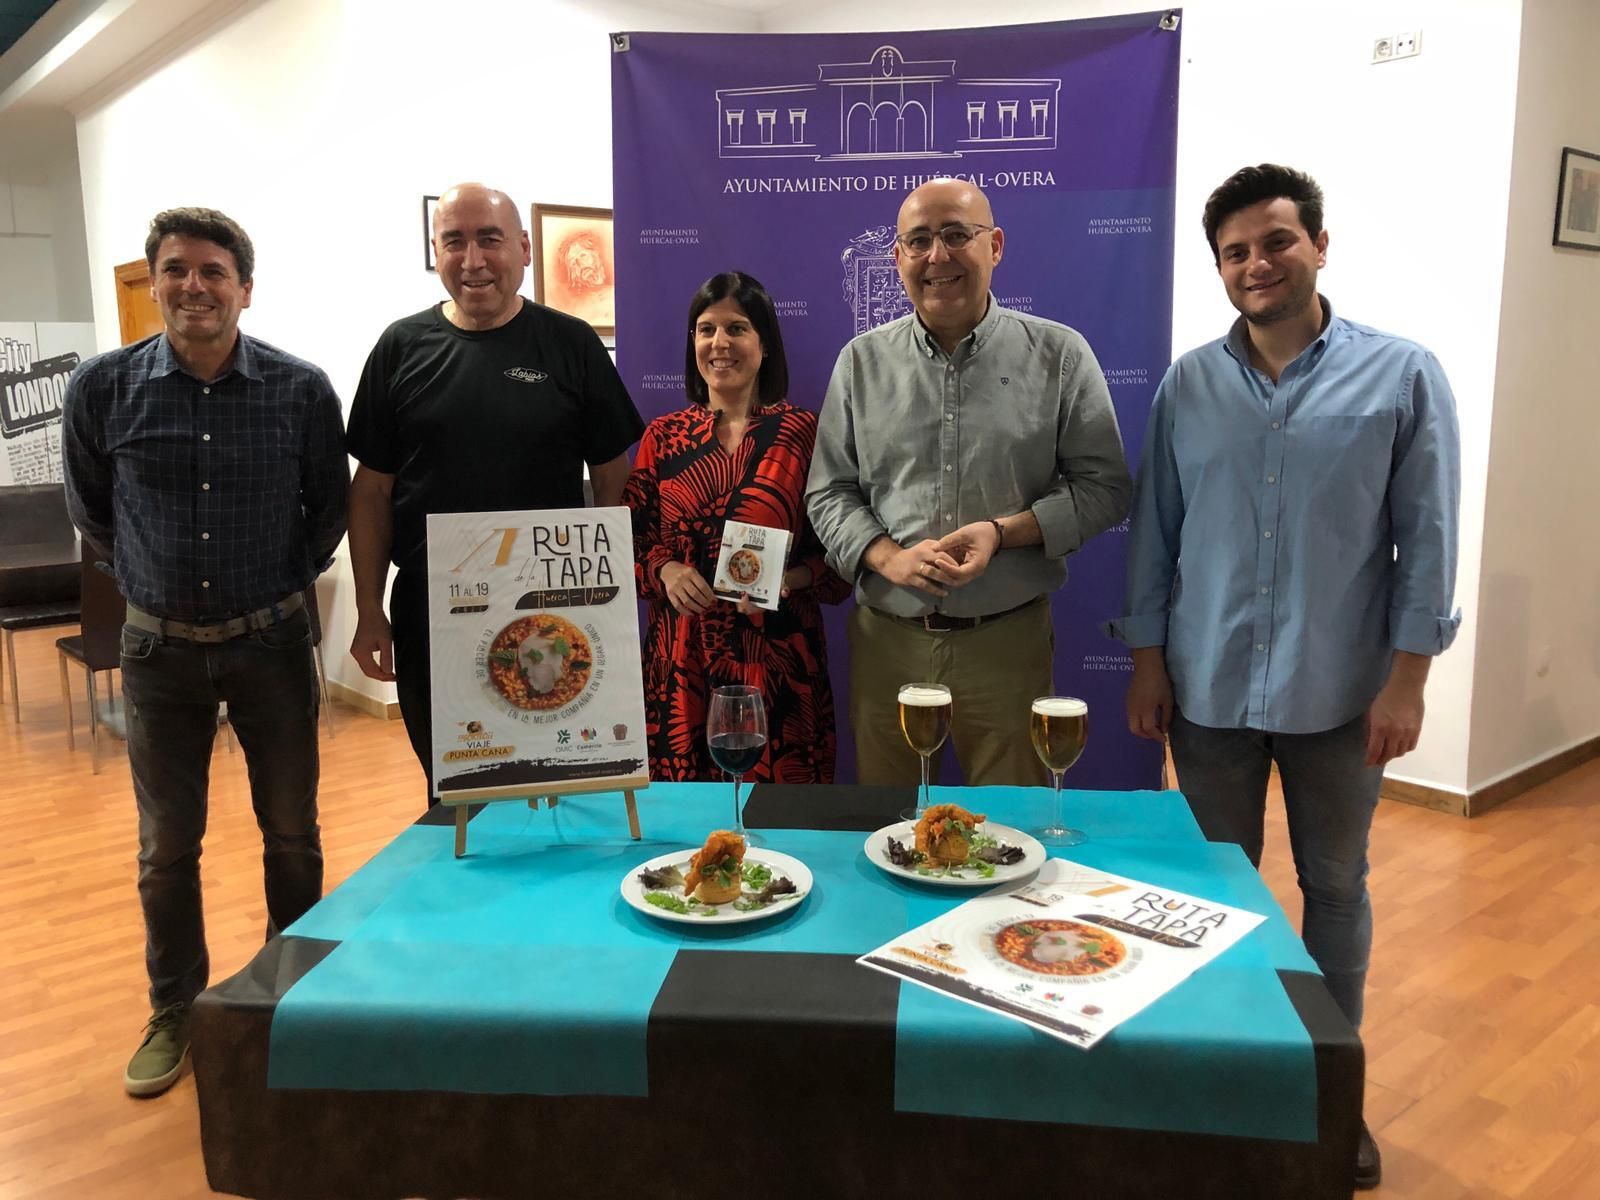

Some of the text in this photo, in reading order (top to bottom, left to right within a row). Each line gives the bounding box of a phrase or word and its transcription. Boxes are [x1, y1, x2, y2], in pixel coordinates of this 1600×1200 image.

[723, 171, 1056, 193] AYUNTAMIENTO DE HUAL-OVERA
[1089, 217, 1152, 226] AYUNTAMIENTO
[774, 300, 808, 308] AMIENTO
[997, 296, 1033, 304] AMIENTO
[642, 374, 686, 382] AYUNTAMIE
[533, 523, 611, 556] RUTA
[540, 555, 614, 588] TAPA
[449, 582, 489, 597] 11 AL 19
[507, 708, 519, 720] EN
[466, 740, 491, 749] VIAJE
[450, 747, 509, 760] PUNTA CANA
[1132, 891, 1228, 928] RUTA
[1123, 906, 1208, 942] TAPA
